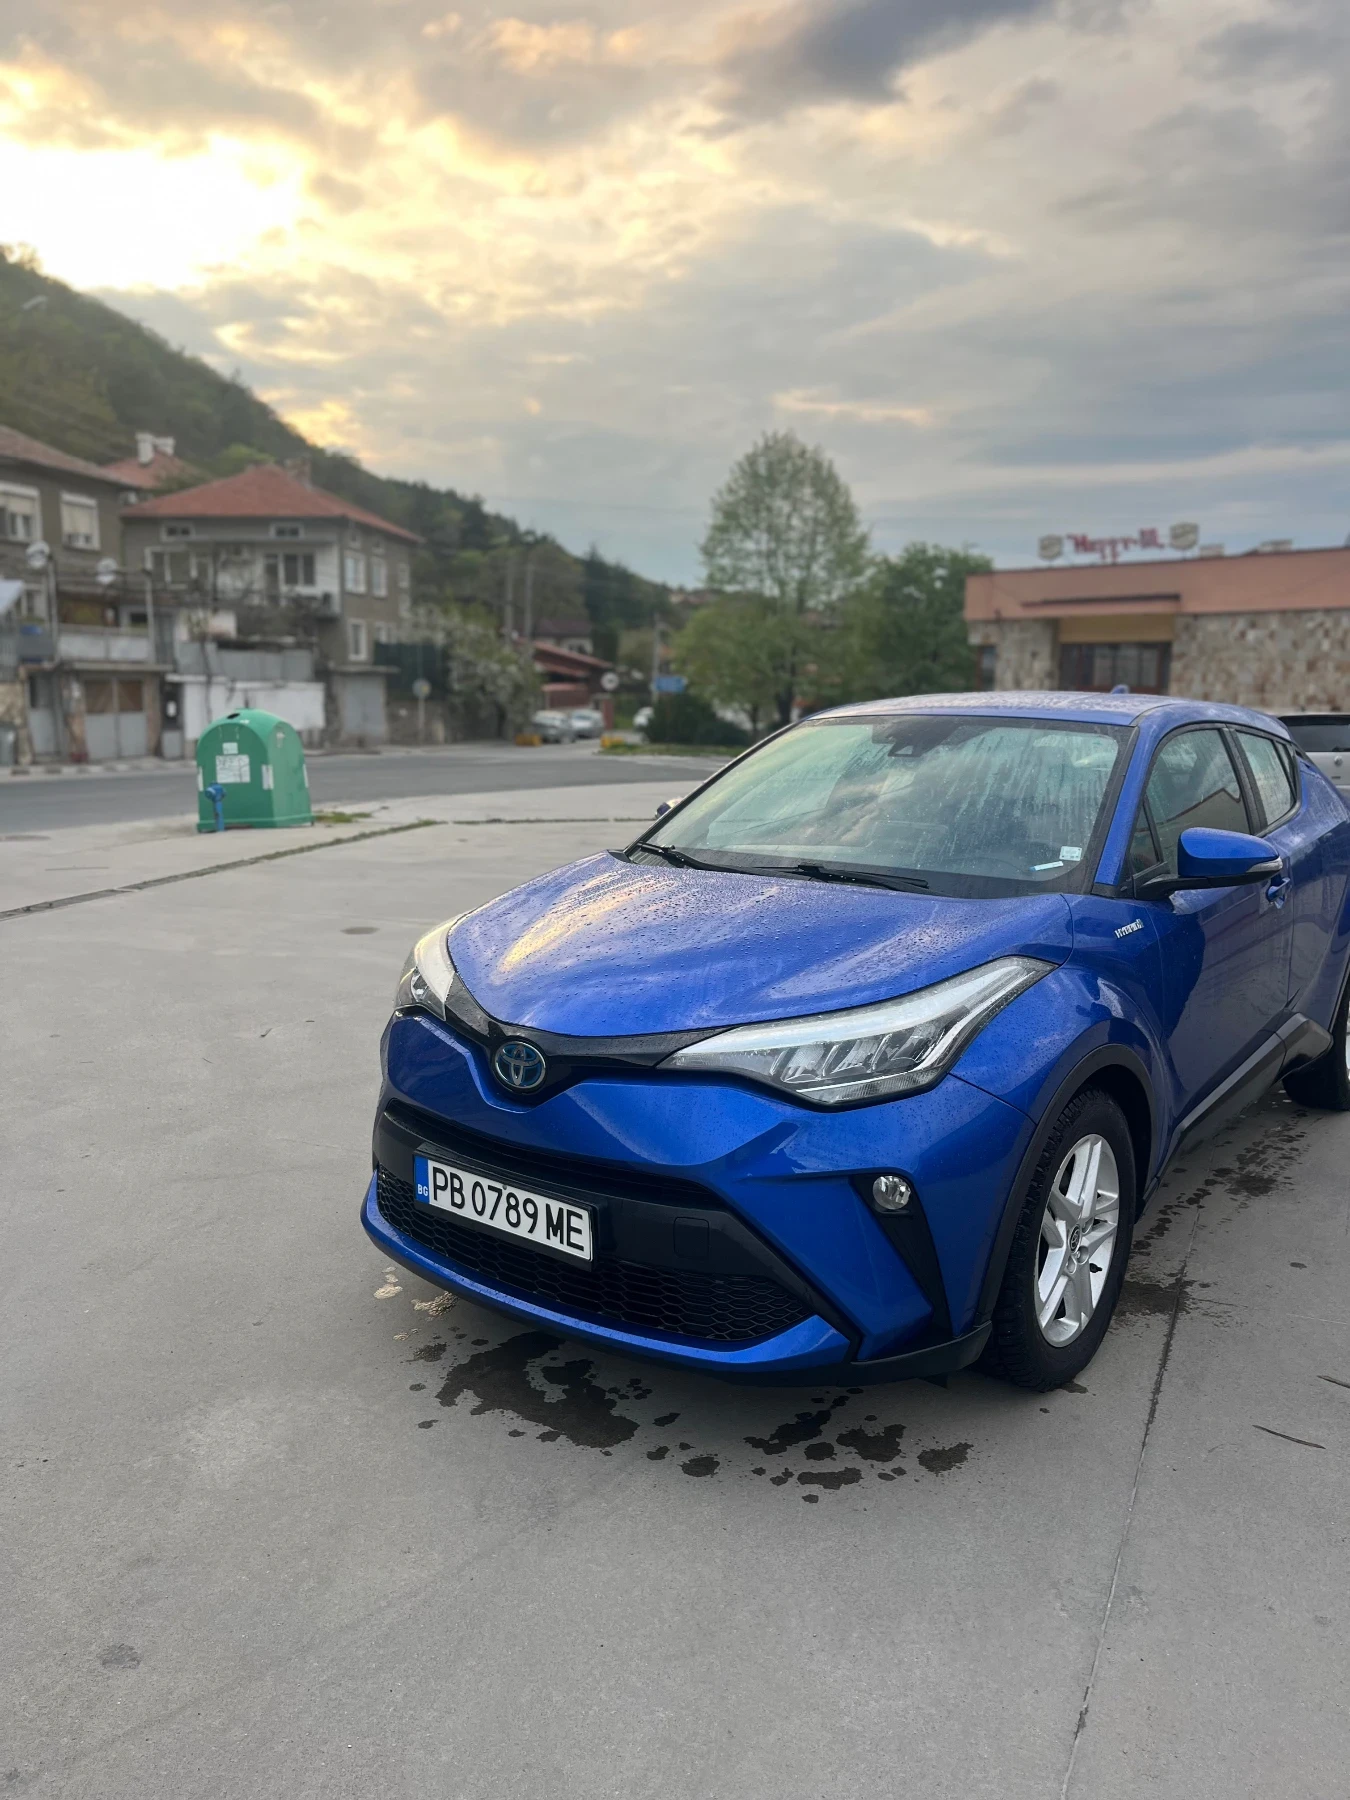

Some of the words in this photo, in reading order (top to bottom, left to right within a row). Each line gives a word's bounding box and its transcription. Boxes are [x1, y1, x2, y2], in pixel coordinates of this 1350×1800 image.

[417, 1183, 429, 1197] BG
[432, 1166, 466, 1209] PB
[471, 1180, 539, 1234] 0789
[545, 1203, 585, 1252] ME
